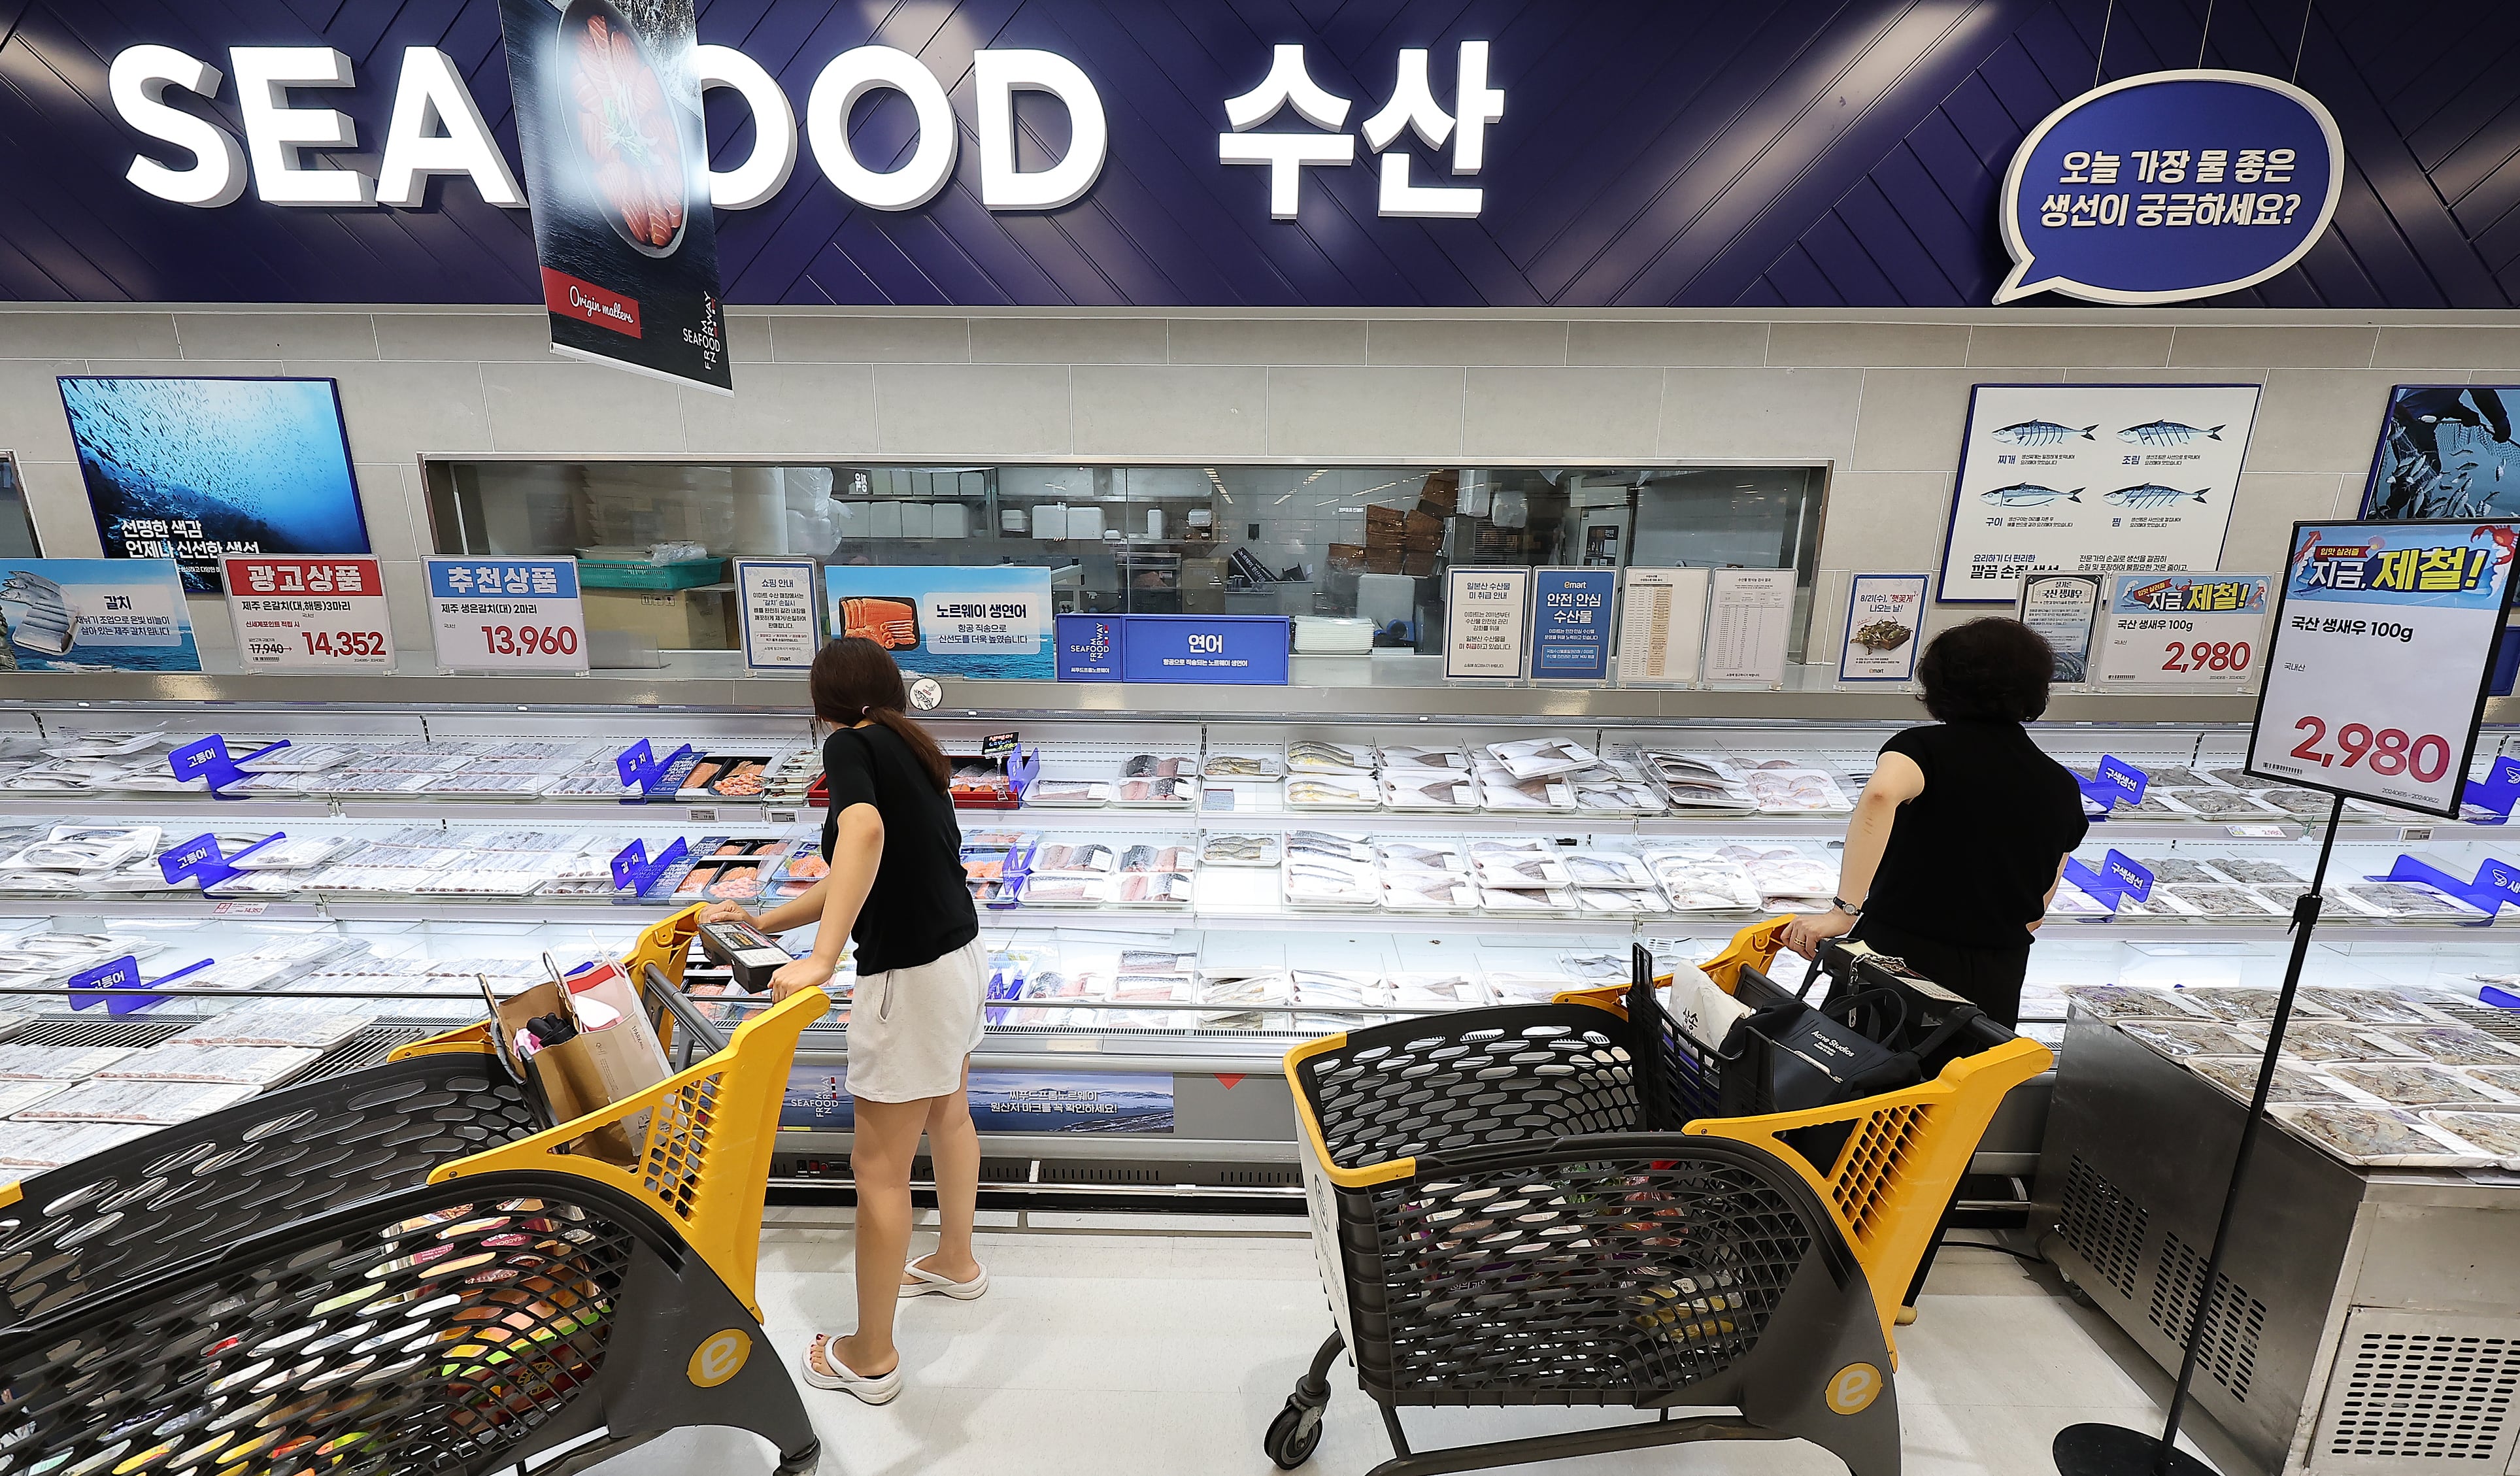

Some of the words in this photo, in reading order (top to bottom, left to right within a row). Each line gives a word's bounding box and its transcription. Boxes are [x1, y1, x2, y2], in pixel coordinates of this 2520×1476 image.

[109, 43, 1107, 210] SEAOOD
[1218, 40, 1505, 220] 수산
[2058, 150, 2121, 184] 오늘
[2130, 150, 2191, 184] 가장
[2196, 150, 2228, 183] 물
[2234, 148, 2296, 183] 좋은
[2040, 193, 2130, 227] 생선이
[2135, 192, 2302, 226] 궁금하세요?
[569, 285, 601, 318] Origin
[602, 303, 634, 324] matters
[703, 291, 717, 363] NORWAY
[682, 327, 720, 352] SEAFOOD
[701, 320, 712, 370] FROM
[1998, 455, 2016, 464] 찌개
[2122, 456, 2140, 465] 조림
[121, 520, 169, 537] 선명한
[171, 520, 203, 538] 색감
[1986, 518, 2003, 526] 구이
[2112, 518, 2121, 527] 찜
[126, 541, 174, 558] 언제나
[177, 541, 223, 558] 신선한
[2320, 547, 2335, 556] 입맛
[2336, 547, 2359, 556] 살려줄
[1970, 565, 1998, 579] 깔끔
[2308, 561, 2366, 589] 지금,
[2371, 547, 2486, 590] 제철!
[247, 565, 363, 592] 광고상품
[448, 567, 557, 594] 추천상품
[762, 579, 777, 588] 쇼핑
[779, 579, 794, 588] 안내
[104, 595, 132, 610] 갈치
[1547, 594, 1601, 607] 안전·안심
[2041, 590, 2058, 598] 국산
[2059, 590, 2083, 598] 생새우
[2147, 592, 2185, 611] 지금,
[2187, 582, 2249, 610] 제철!
[242, 601, 261, 611] 제주
[263, 601, 351, 611] 은갈치(대,해동)3마리
[441, 603, 459, 613] 제주
[461, 603, 512, 614] 생은갈치(대)
[514, 604, 537, 614] 2마리
[936, 604, 986, 618] 노르웨이
[989, 604, 1026, 618] 생연어
[1554, 610, 1592, 624] 수산물
[2117, 620, 2137, 629] 국산
[2138, 620, 2166, 629] 생새우
[2169, 620, 2193, 631] 100g
[958, 624, 973, 633] 항공
[975, 624, 1007, 633] 직송으로
[2291, 616, 2320, 631] 국산
[2322, 619, 2366, 635] 생새우
[2370, 621, 2413, 643] 100g
[250, 643, 284, 654] 17,940
[302, 631, 387, 658] 14,352
[481, 625, 578, 656] 13,960
[989, 635, 1027, 644] 높였습니다
[1096, 622, 1104, 659] NORWAY
[1188, 634, 1223, 654] 연어
[2162, 641, 2251, 673] 2,980
[2284, 662, 2306, 672] 국내산
[187, 748, 216, 767] 고등어
[2290, 715, 2451, 783] 2,980
[2105, 767, 2138, 792] 구색생선
[176, 847, 208, 869] 고등어
[2111, 862, 2143, 890] 구색생선
[90, 970, 126, 989] 고등어
[1811, 1030, 1830, 1043] Acne
[1828, 1039, 1855, 1057] Studios
[821, 1075, 832, 1114] NORWAY
[815, 1092, 824, 1118] FROM
[990, 1103, 1020, 1113] 원산지
[1022, 1103, 1051, 1113] 마크를
[1053, 1103, 1063, 1113] 꼭
[1065, 1103, 1118, 1114] 확인하세요!
[496, 1236, 526, 1245] PEACOCK
